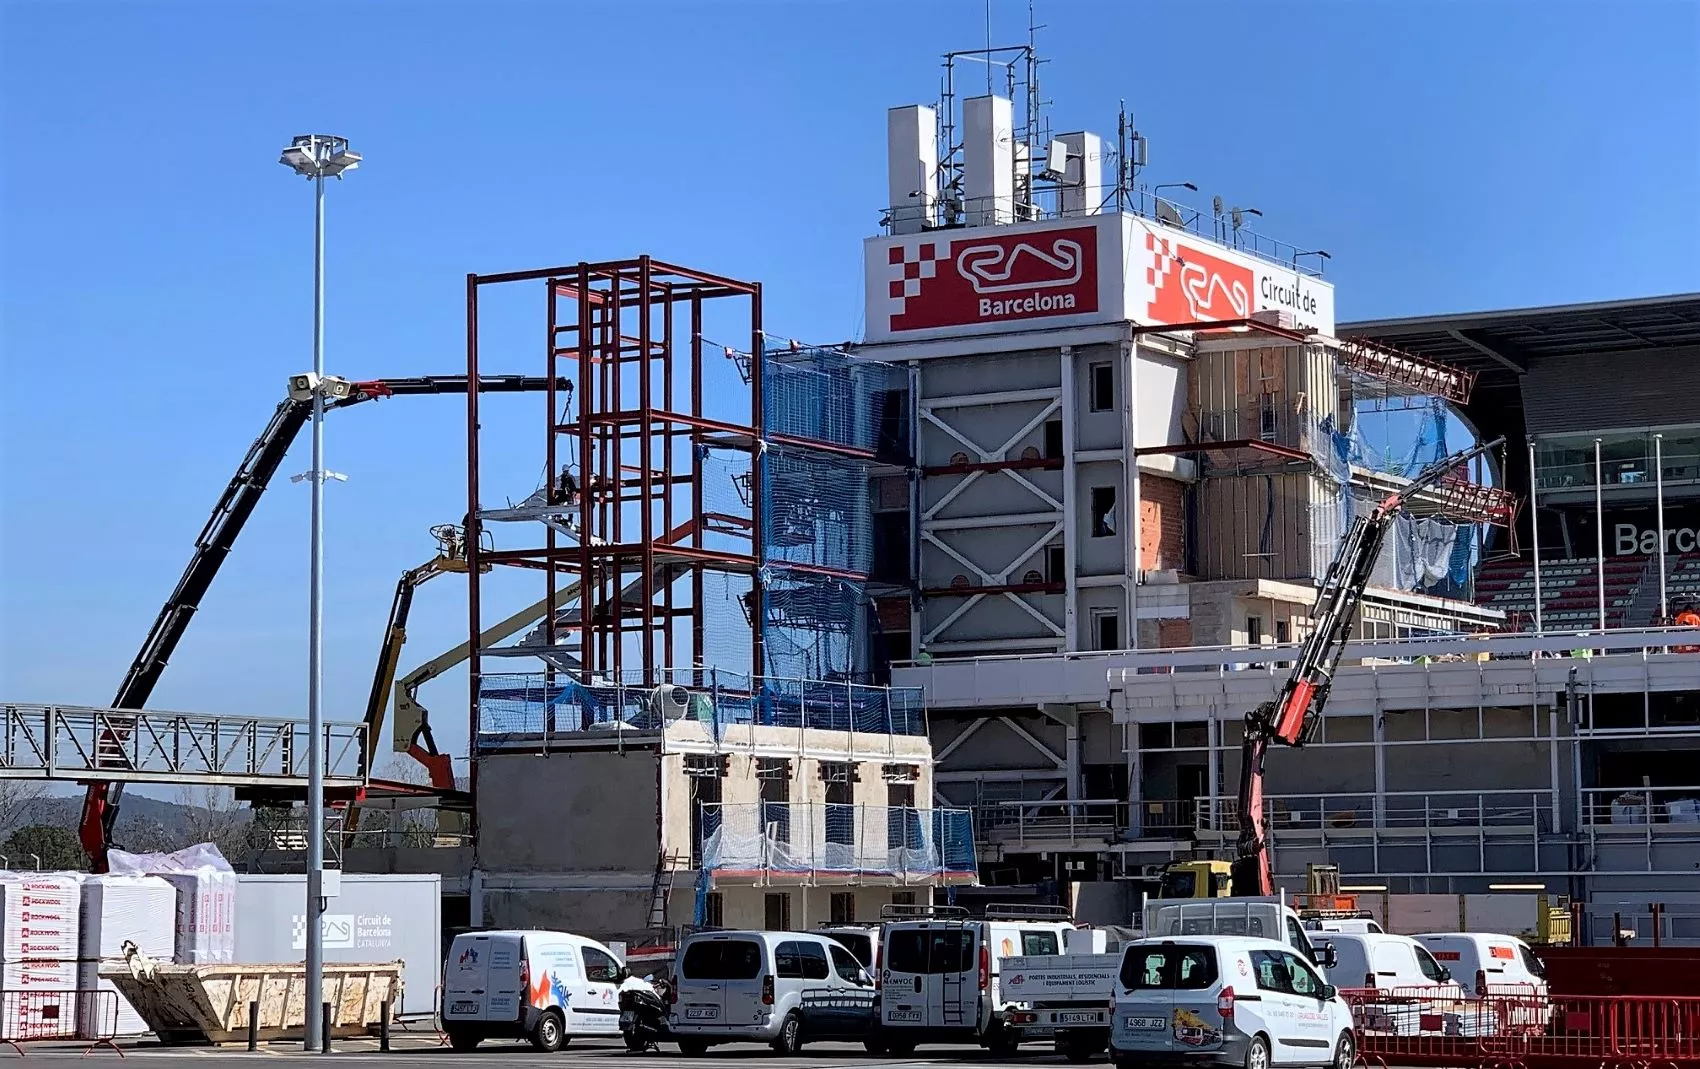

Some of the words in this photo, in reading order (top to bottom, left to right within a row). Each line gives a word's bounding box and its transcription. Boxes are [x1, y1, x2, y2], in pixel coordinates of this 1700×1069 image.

[980, 292, 1076, 317] Barcelona
[1261, 276, 1301, 310] Circuit
[1303, 290, 1317, 315] de
[1615, 523, 1700, 555] Barc
[357, 914, 381, 925] Circuit
[382, 914, 391, 925] de
[357, 926, 391, 937] Barcelona
[1150, 1019, 1163, 1027] JZZ
